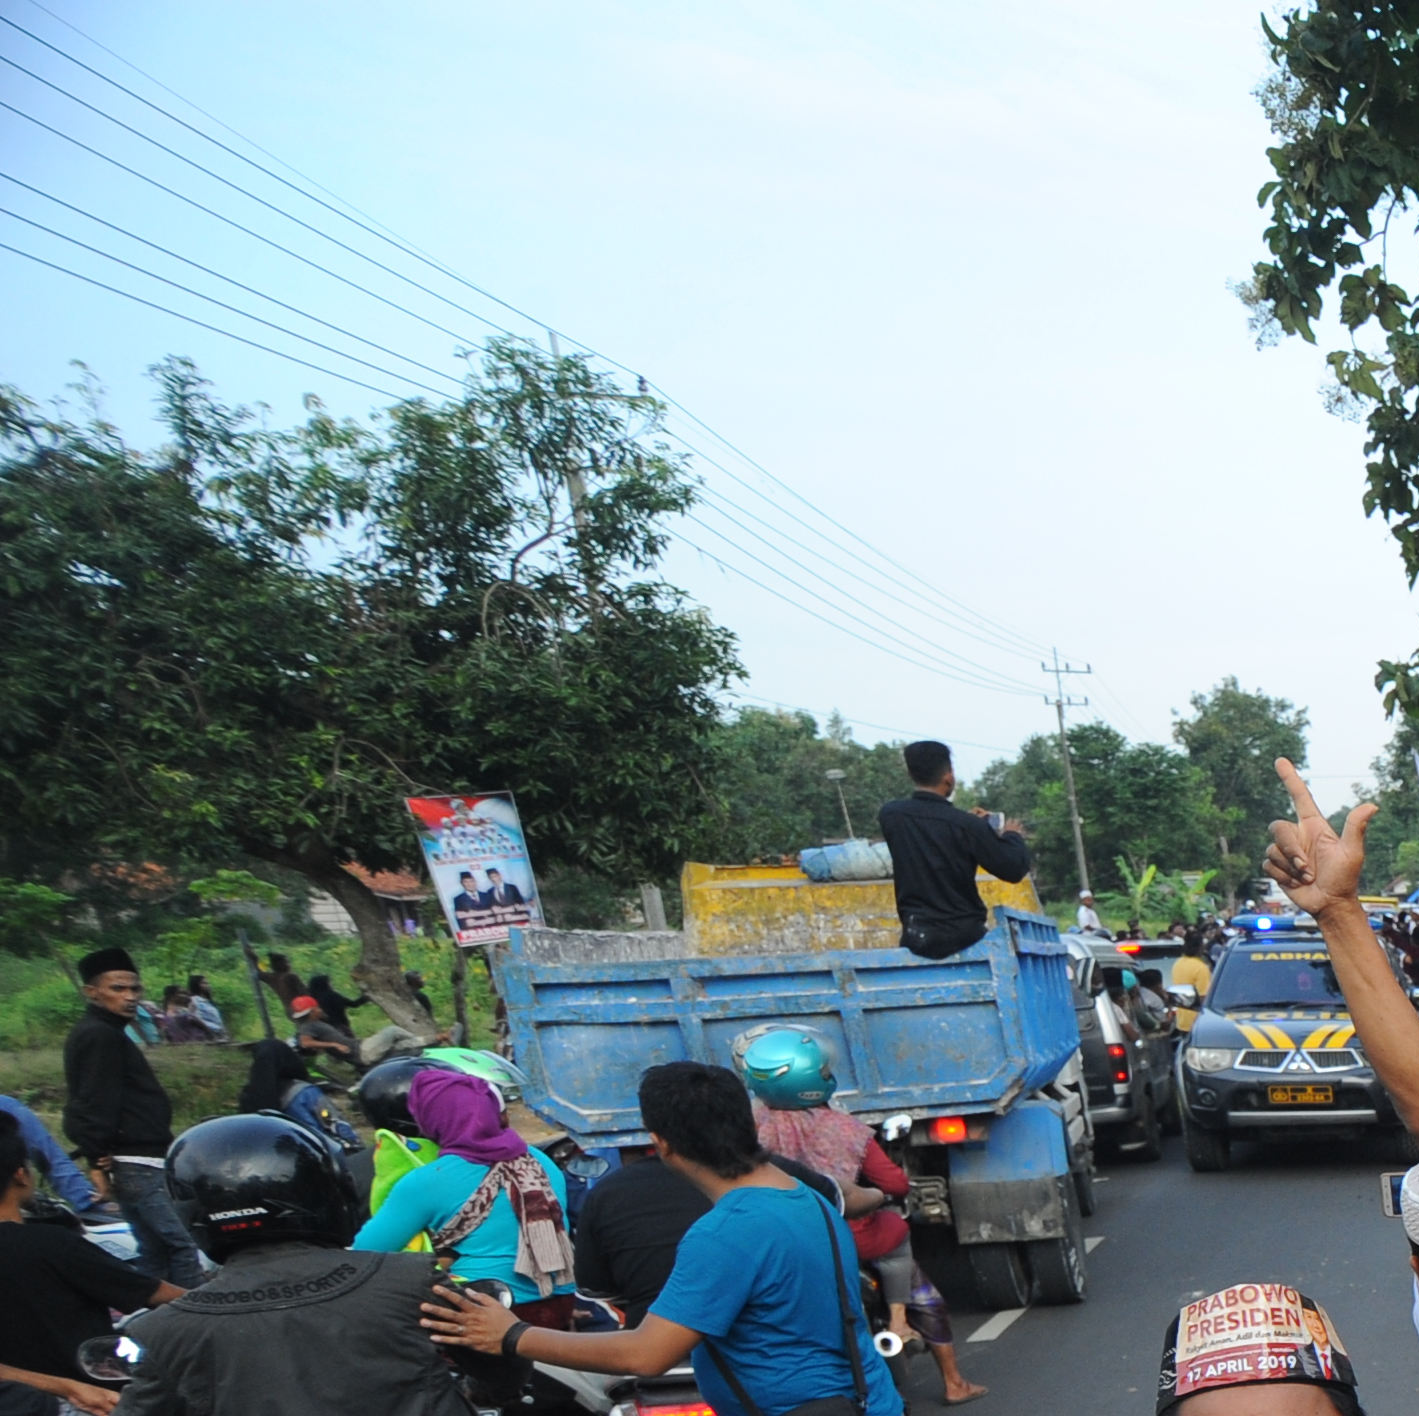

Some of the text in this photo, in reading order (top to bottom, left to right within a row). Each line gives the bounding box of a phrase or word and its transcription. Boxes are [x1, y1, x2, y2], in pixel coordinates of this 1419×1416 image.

[1251, 952, 1331, 961] SABHA
[208, 1206, 269, 1221] HONDA
[1186, 1284, 1297, 1322] PRABOWO
[1187, 1307, 1301, 1343] PRESIDEN
[1187, 1369, 1202, 1383] 17
[1205, 1358, 1253, 1378] APRIL
[1258, 1355, 1297, 1370] 2019
